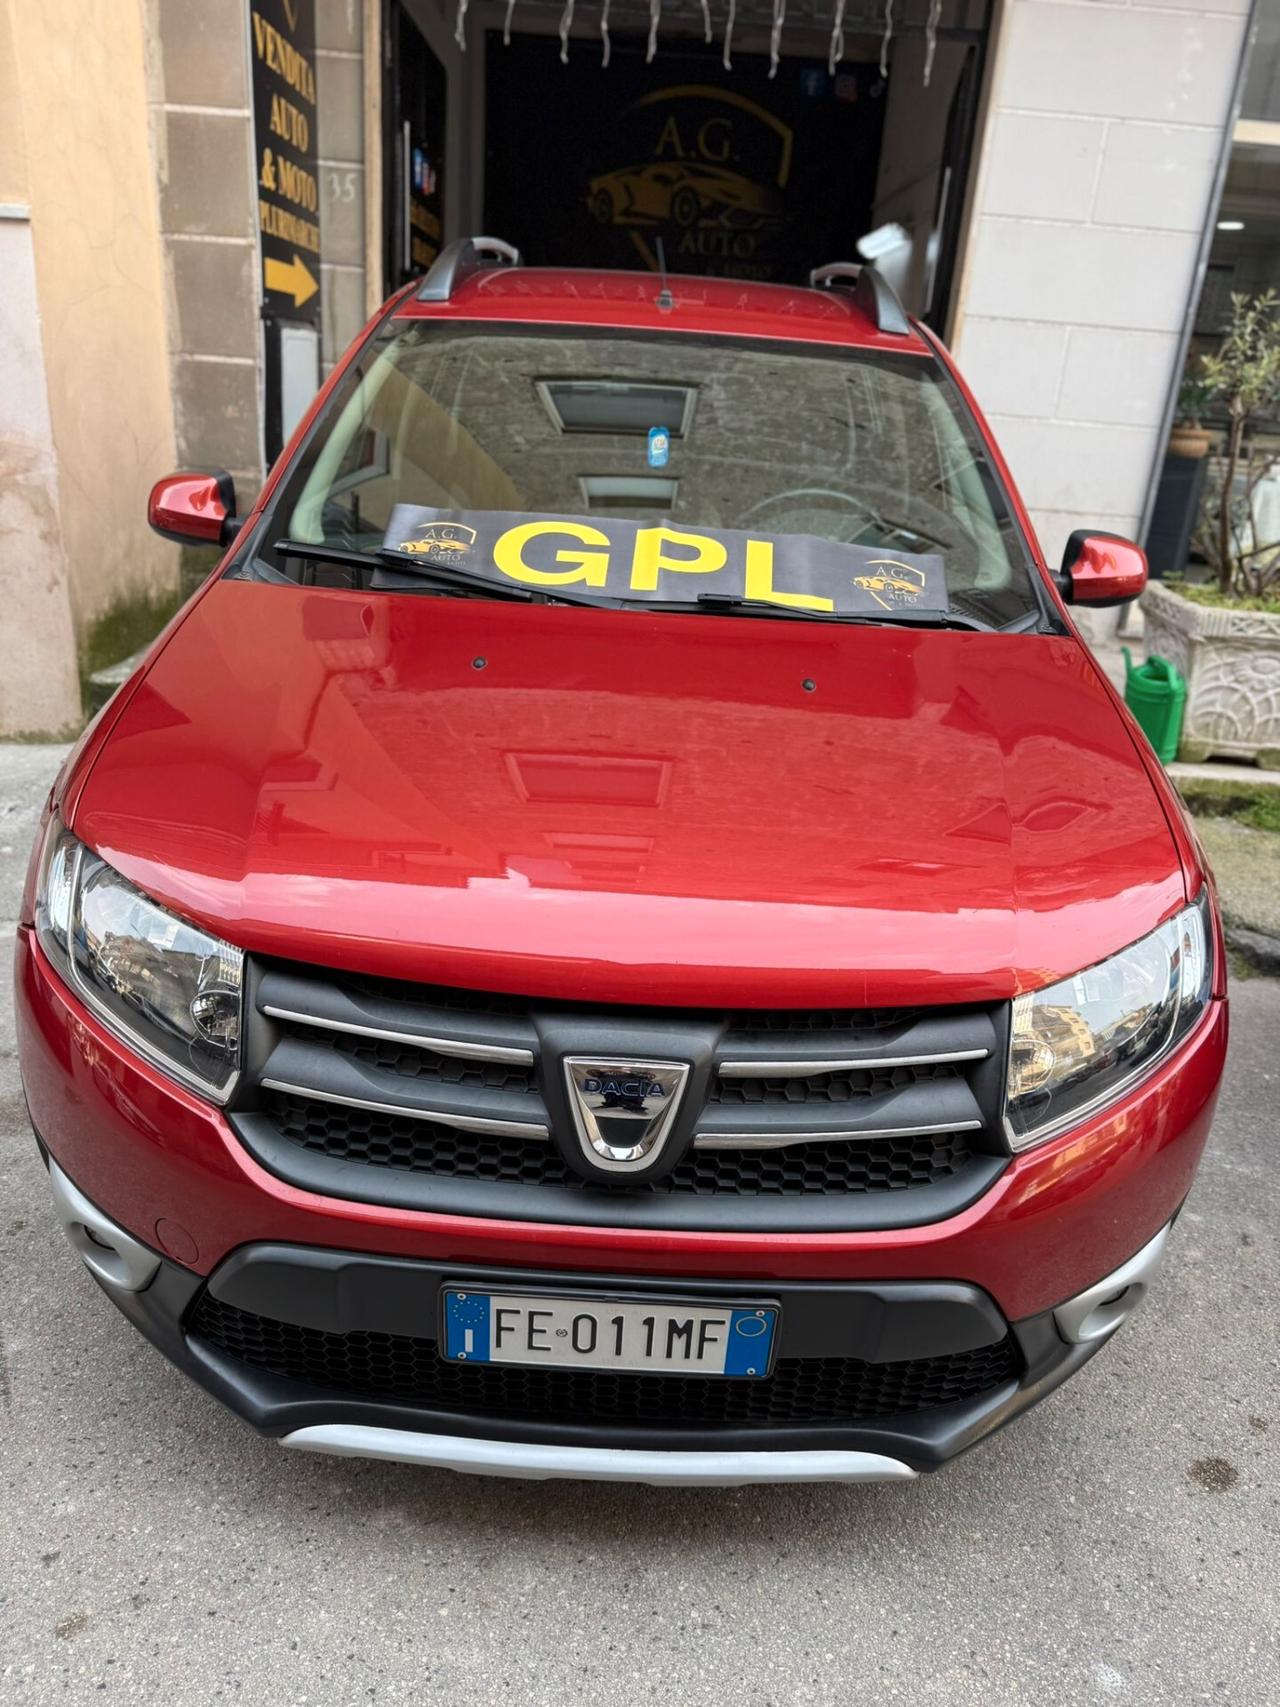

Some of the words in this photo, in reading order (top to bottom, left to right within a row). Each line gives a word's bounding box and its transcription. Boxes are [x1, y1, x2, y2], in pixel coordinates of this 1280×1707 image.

[252, 11, 315, 105] VENDITA
[269, 93, 309, 153] AUTO
[655, 114, 742, 162] A.G.
[261, 147, 276, 191] &
[277, 155, 317, 213] MOTO
[329, 173, 357, 203] 35
[678, 230, 756, 258] AUTO
[493, 521, 834, 613] GPL
[583, 1077, 666, 1098] DACIA
